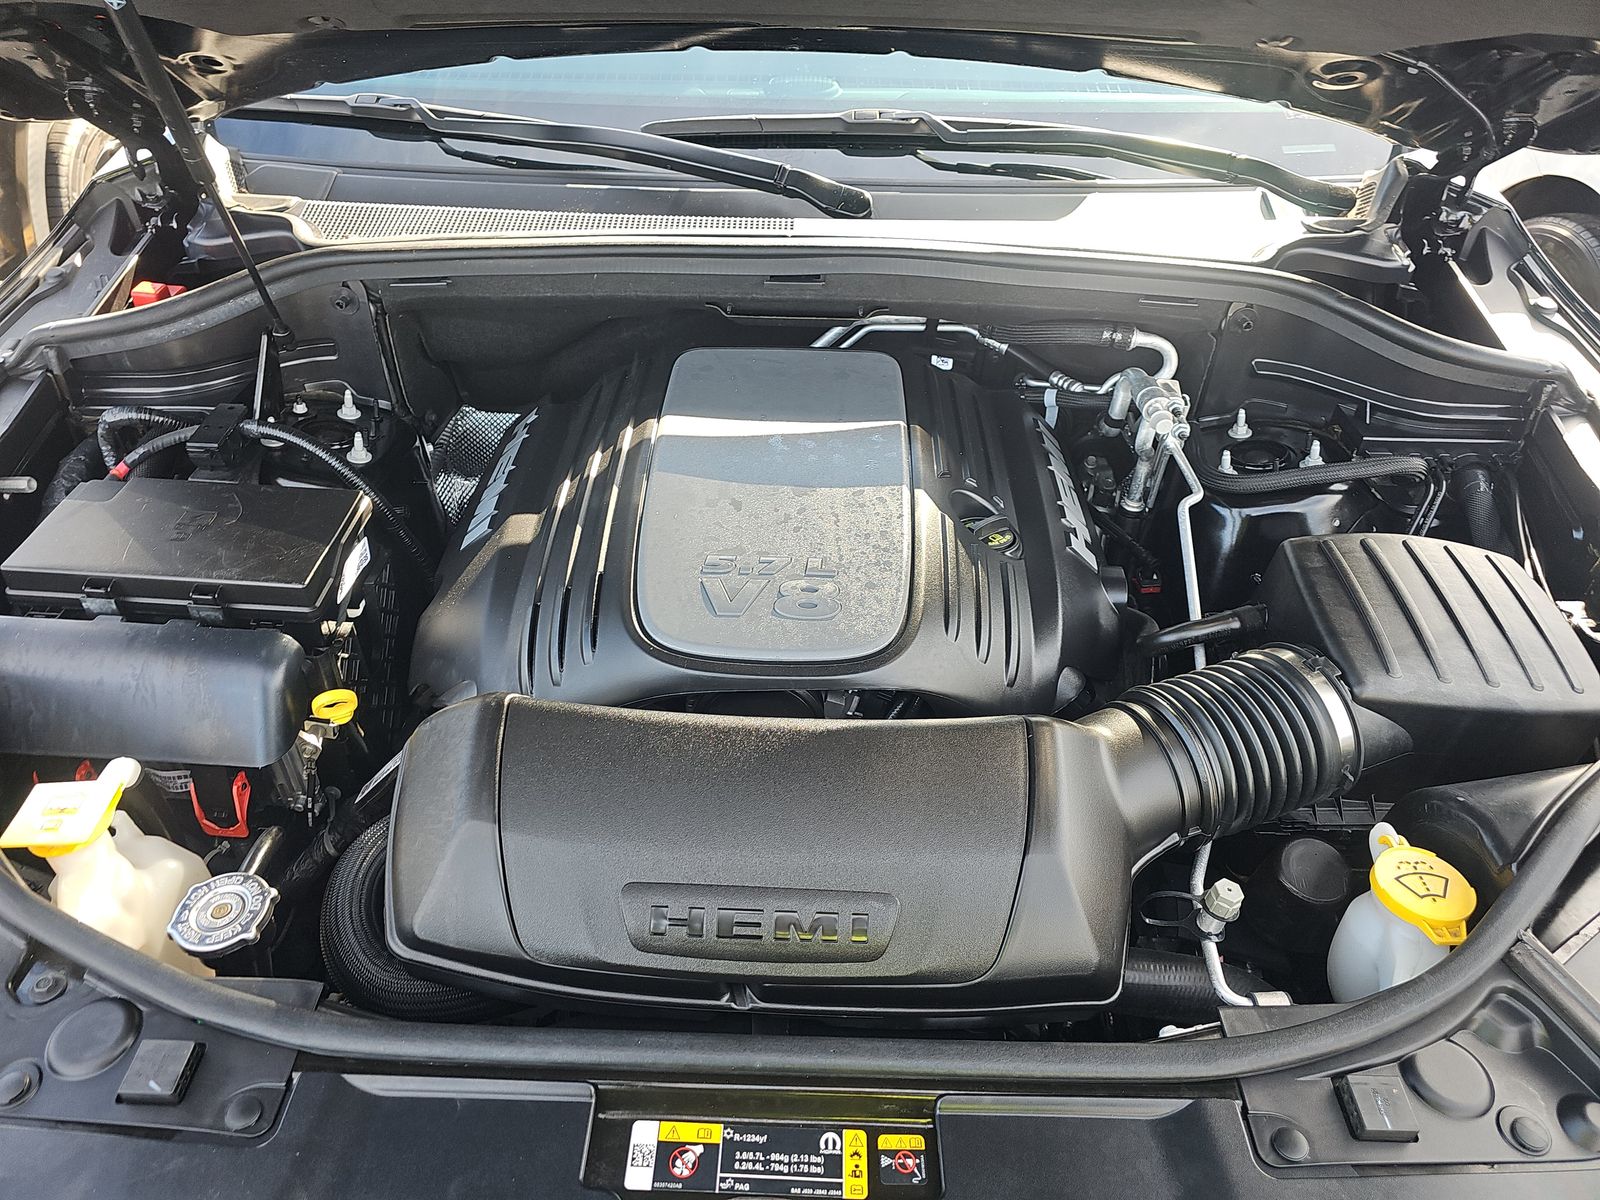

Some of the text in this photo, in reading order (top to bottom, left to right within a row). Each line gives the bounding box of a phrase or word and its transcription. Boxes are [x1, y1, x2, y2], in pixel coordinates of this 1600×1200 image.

[1036, 418, 1098, 573] HEMI
[701, 554, 839, 578] 5.7 L
[700, 578, 842, 621] V8
[211, 875, 245, 890] OPEN
[650, 905, 870, 944] HEMI
[206, 924, 243, 944] KEEP
[733, 1133, 768, 1144] R-1234yf
[791, 1153, 809, 1163] (2.13
[810, 1154, 825, 1165] lbs)
[790, 1163, 809, 1174] (1.75
[810, 1164, 825, 1175] lbs)
[734, 1182, 750, 1191] PAG
